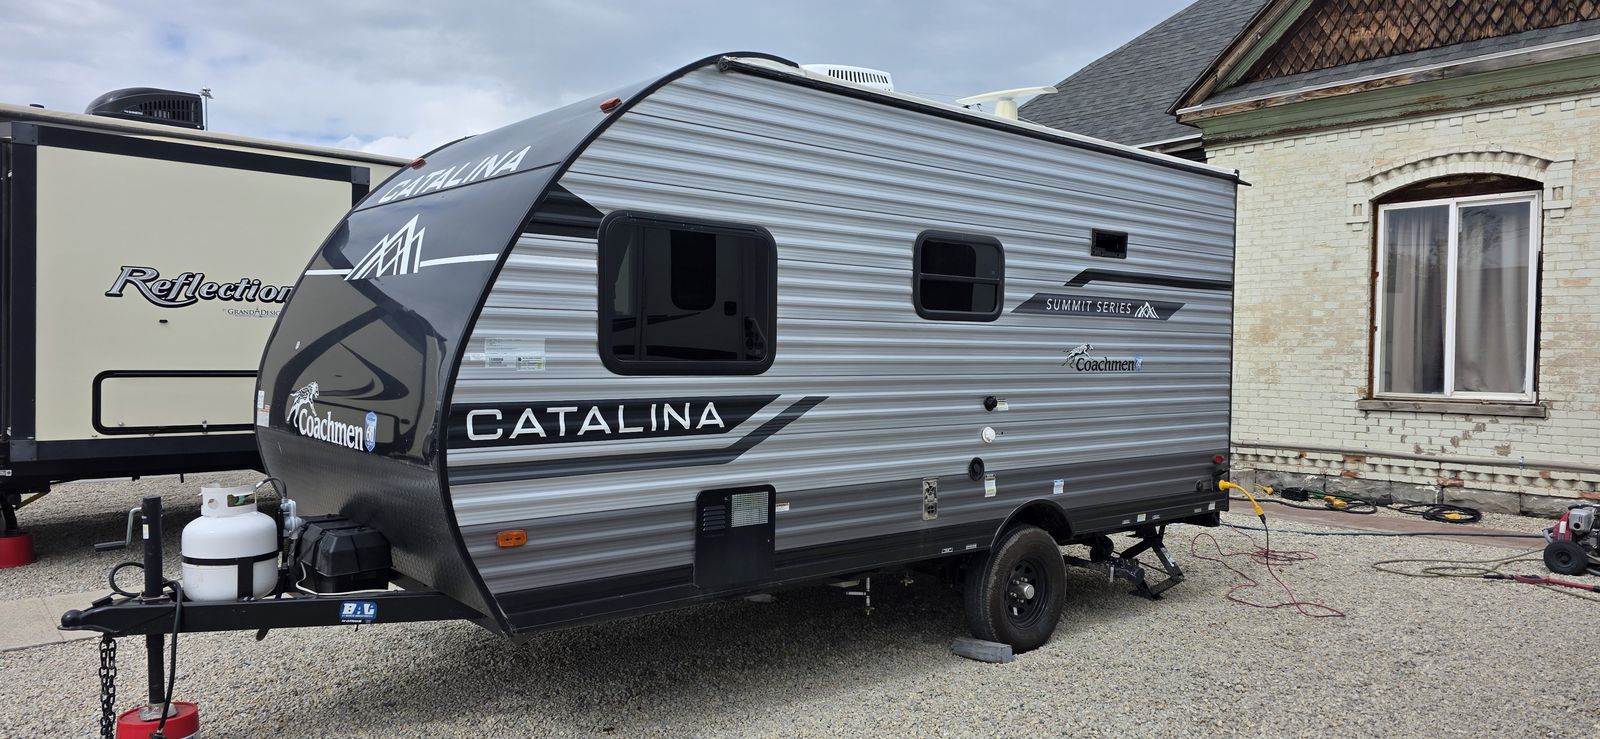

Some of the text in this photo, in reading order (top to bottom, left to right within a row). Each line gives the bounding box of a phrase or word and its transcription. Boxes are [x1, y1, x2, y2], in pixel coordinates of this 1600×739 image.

[378, 145, 531, 204] CATALINA
[227, 308, 254, 316] GRAND
[1046, 298, 1132, 314] SUMMIT SERIES
[1075, 356, 1135, 372] Coachmen
[299, 408, 364, 452] Coachmen
[466, 402, 725, 441] CATALINA
